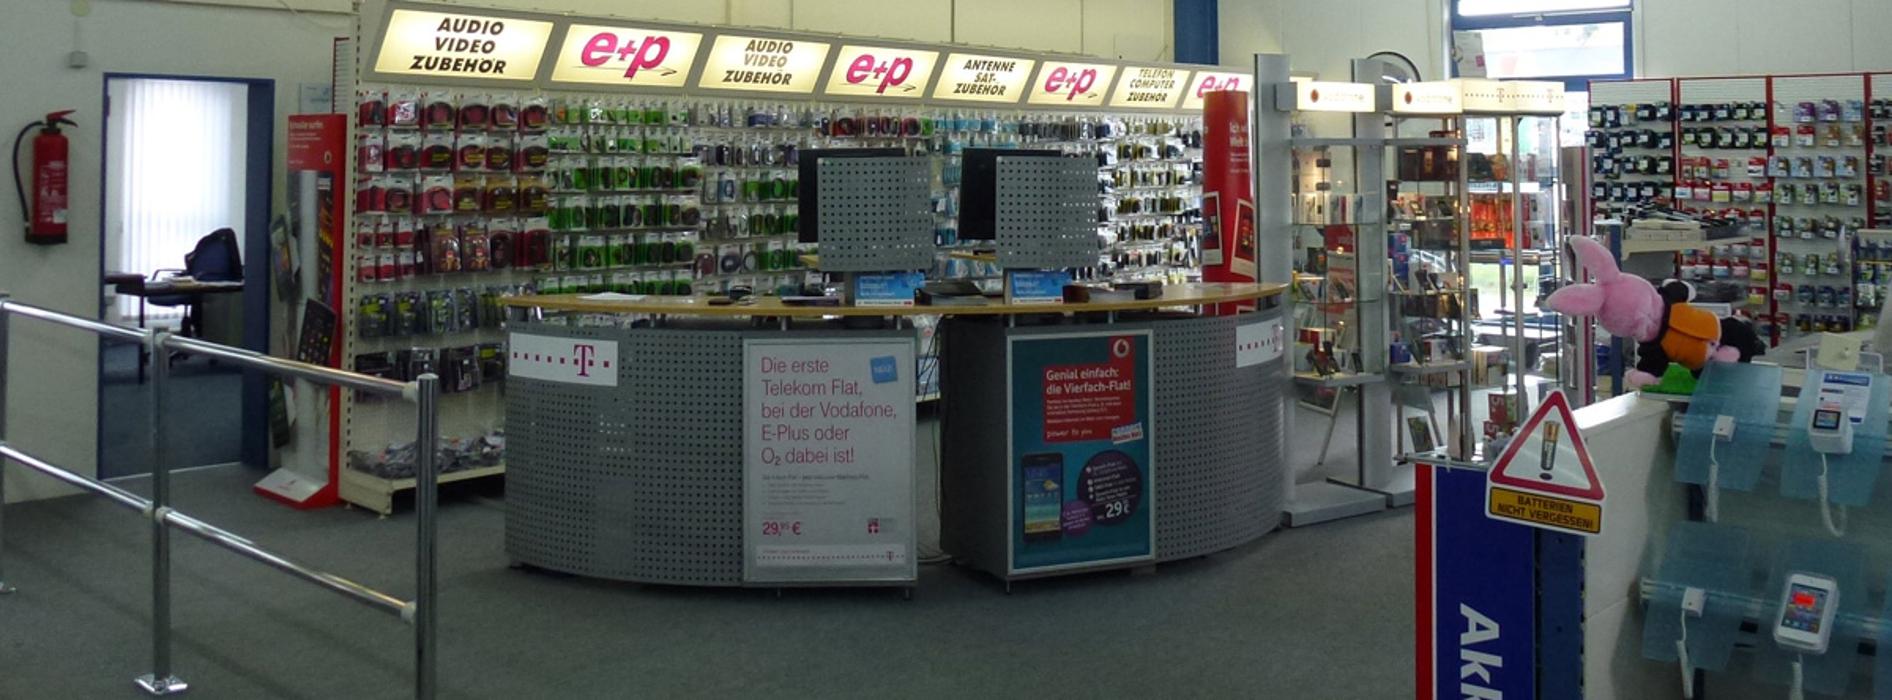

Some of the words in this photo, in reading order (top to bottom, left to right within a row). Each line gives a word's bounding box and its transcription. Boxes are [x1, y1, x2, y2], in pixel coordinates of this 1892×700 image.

[437, 18, 504, 35] AUDIO
[435, 37, 496, 54] VIDEO
[745, 39, 793, 54] AUDIO
[581, 32, 671, 79] e+p
[743, 53, 788, 68] VIDEO
[410, 55, 507, 74] ZUBEHÖR
[963, 59, 1017, 72] ANTENNE
[722, 69, 793, 85] ZUBEHÖR
[846, 54, 914, 94] e+p
[974, 72, 997, 83] SAT-
[1139, 68, 1175, 79] TELEFON
[1045, 66, 1097, 101] e+p
[1129, 79, 1175, 89] COMPUTER
[760, 356, 787, 374] Die
[791, 358, 830, 374] erste
[1046, 368, 1079, 381] Genial
[1080, 367, 1119, 379] einfach:
[762, 379, 827, 397] Telekom
[831, 378, 863, 397] Flat,
[1046, 384, 1062, 395] die
[1063, 379, 1132, 394] Vierfach-Flat!
[761, 401, 785, 419] bei
[790, 401, 815, 419] der
[820, 401, 897, 420] Vodafone,
[761, 424, 810, 442] E-Plus
[814, 424, 850, 441] oder
[785, 447, 829, 464] dabei
[833, 447, 855, 464] ist!
[1517, 495, 1574, 513] BATTERIEN
[1497, 503, 1526, 516] NICHT
[1529, 509, 1594, 528] VERGESSEN!
